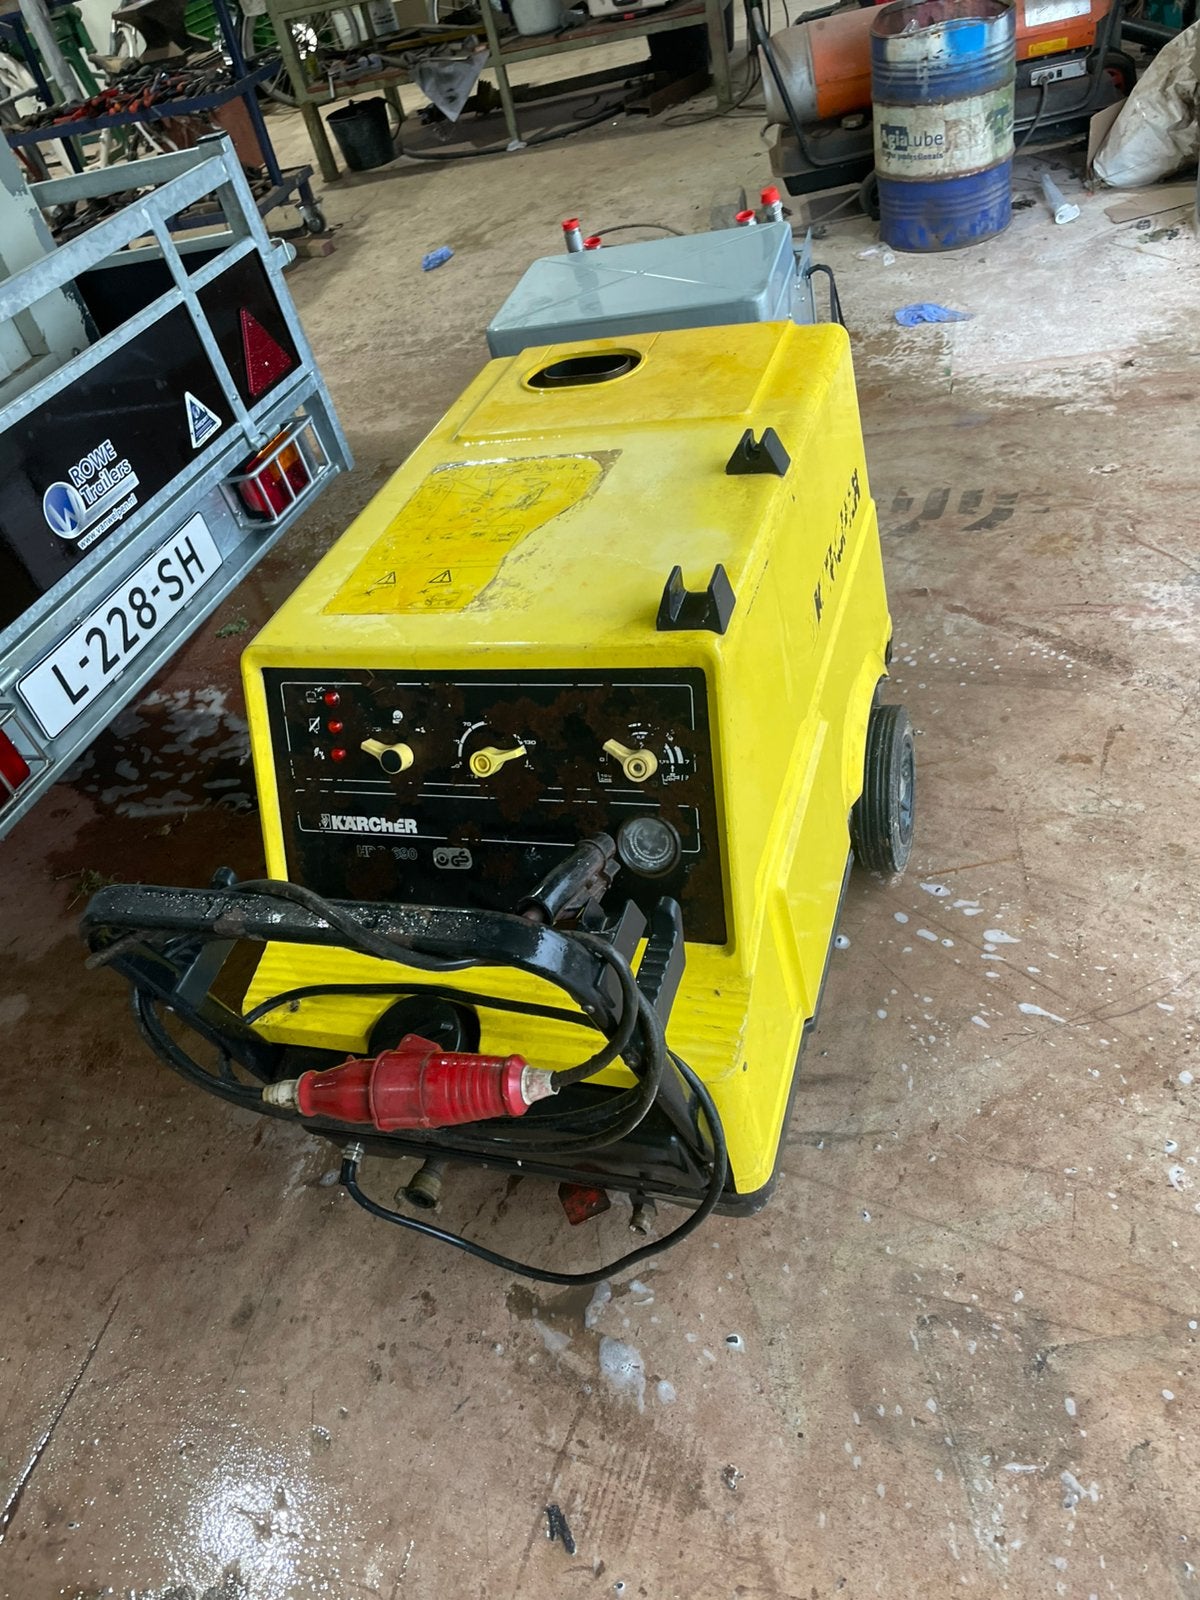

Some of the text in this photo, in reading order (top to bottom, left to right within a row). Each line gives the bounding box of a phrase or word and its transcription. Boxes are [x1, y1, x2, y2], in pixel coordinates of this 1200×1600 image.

[68, 439, 117, 488] ROWE
[79, 459, 132, 505] Trailers
[51, 536, 205, 705] L-228-SH
